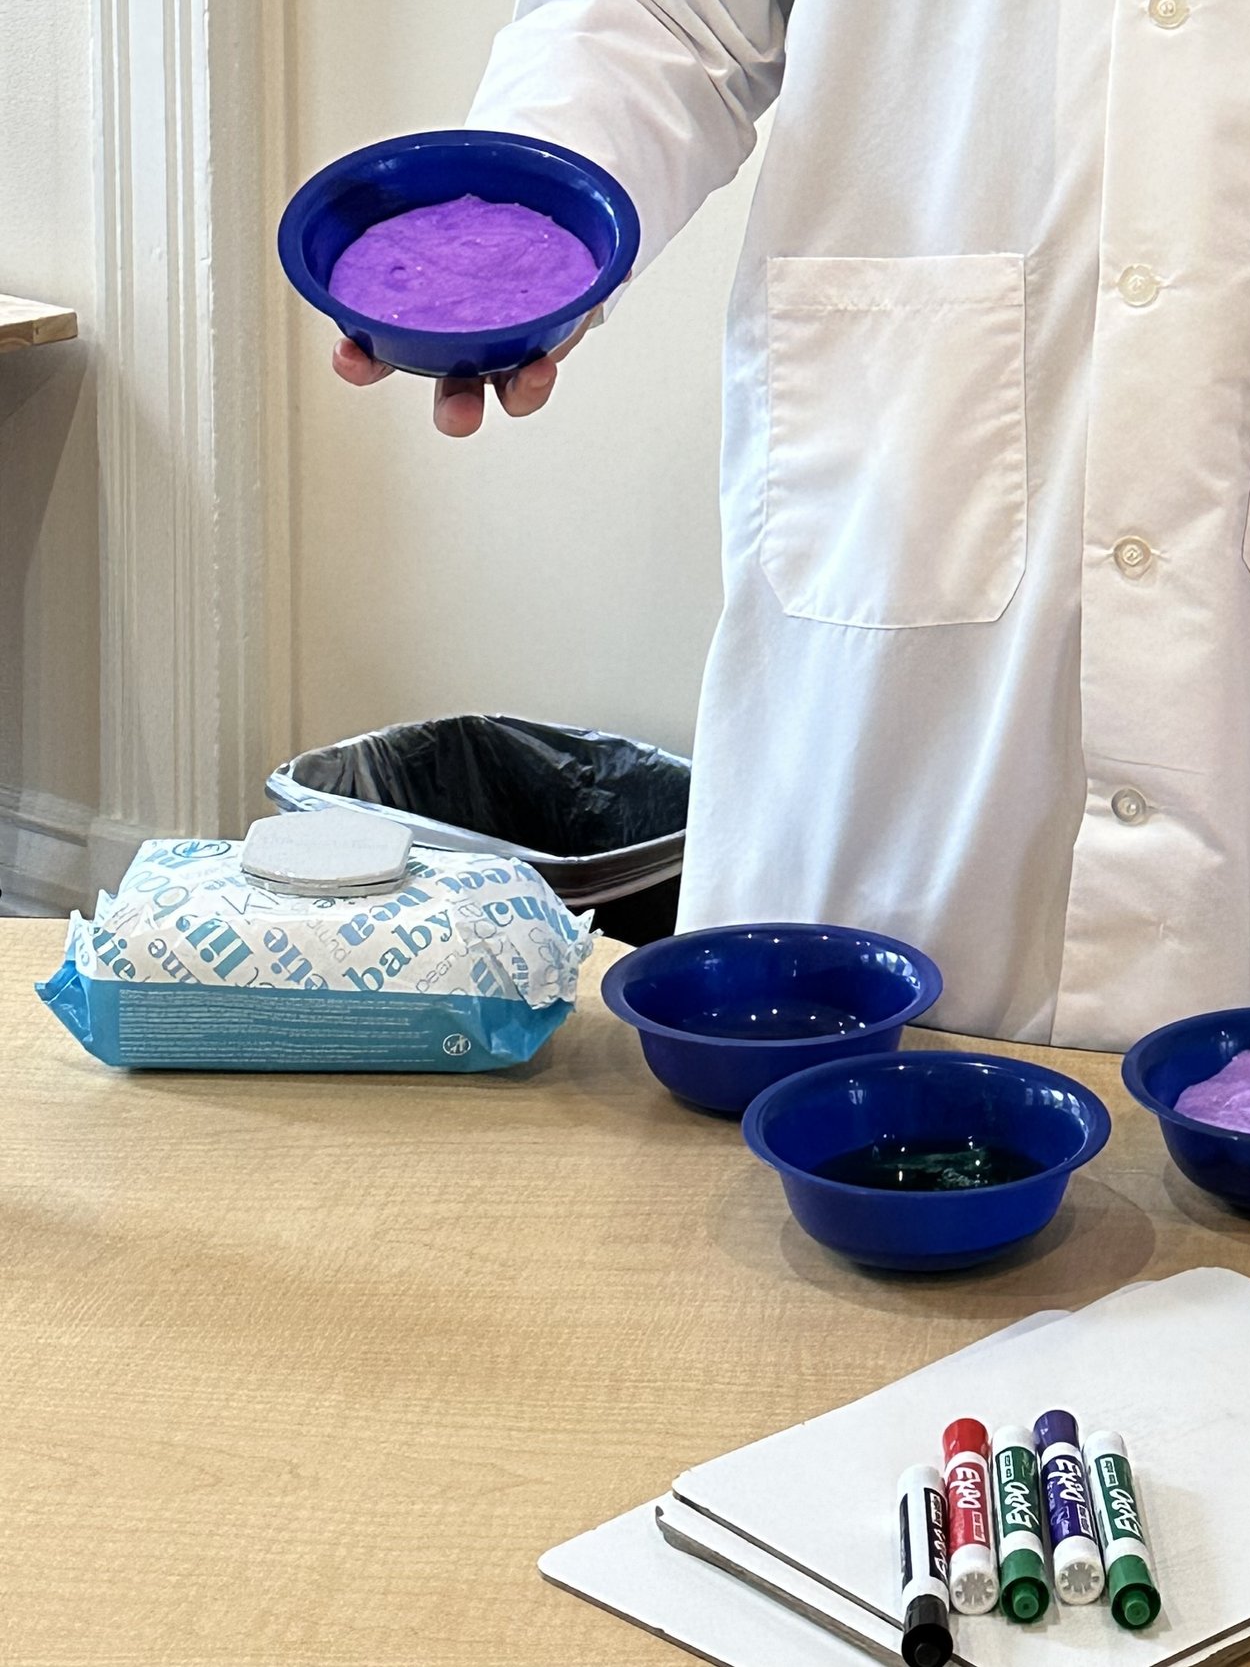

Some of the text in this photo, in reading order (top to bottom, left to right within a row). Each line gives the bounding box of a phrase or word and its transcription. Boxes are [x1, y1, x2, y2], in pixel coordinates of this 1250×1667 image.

[342, 909, 453, 993] baby
[949, 1466, 982, 1509] EXPO
[1048, 1458, 1086, 1503] EXPO
[1004, 1481, 1041, 1529] EXPO
[1109, 1488, 1143, 1539] EXPO
